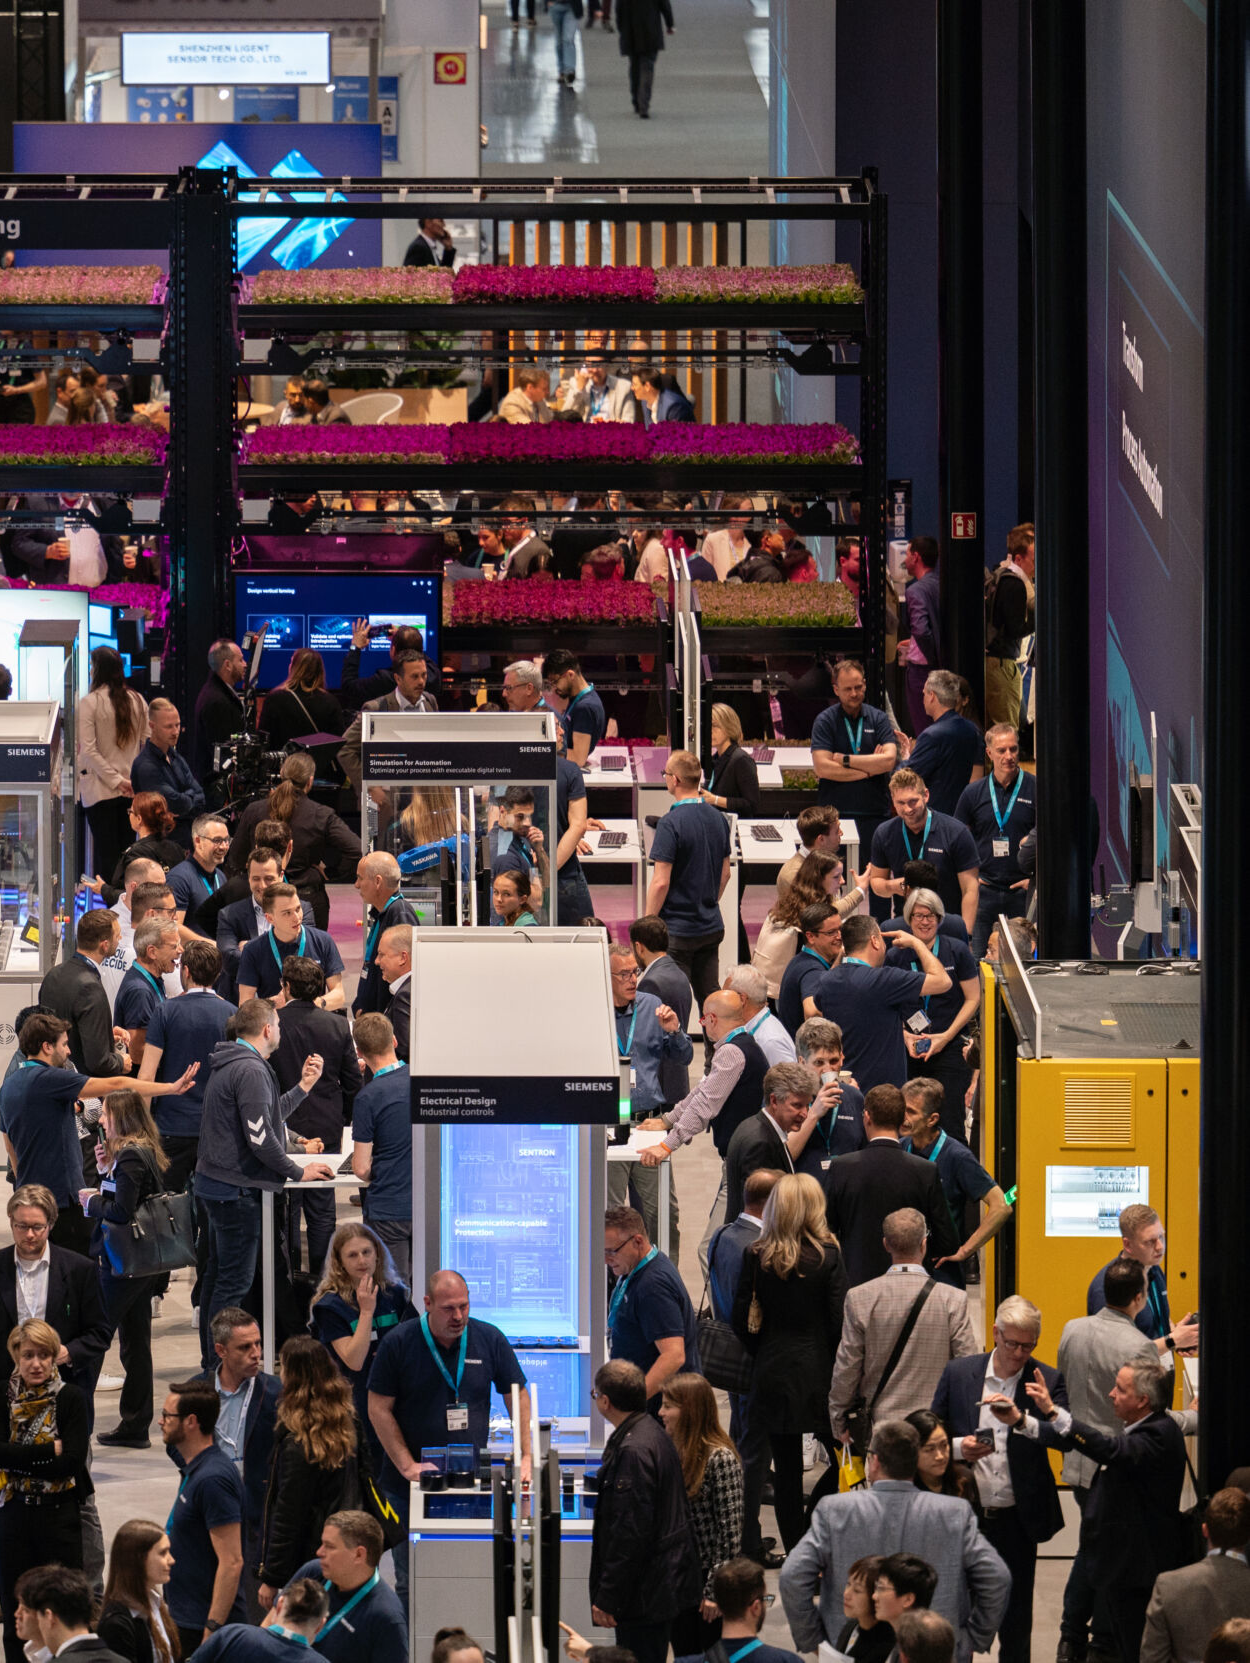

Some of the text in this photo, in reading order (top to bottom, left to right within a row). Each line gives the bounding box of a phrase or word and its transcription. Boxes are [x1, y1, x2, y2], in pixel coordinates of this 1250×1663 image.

[179, 45, 231, 53] SHENZHEN
[167, 55, 207, 63] SENSOR
[211, 55, 237, 63] TECH
[7, 748, 46, 756] SIEMENS
[411, 852, 438, 867] YASKAWA
[115, 949, 126, 959] OU
[102, 956, 128, 972] ECIDE
[565, 1082, 614, 1091] SIEMENS
[420, 1097, 497, 1107] Electrical Design
[420, 1107, 495, 1116] Industrial controls
[518, 1149, 556, 1157] SENTRON
[454, 1219, 548, 1229] Communication-capable
[454, 1229, 494, 1237] Protection
